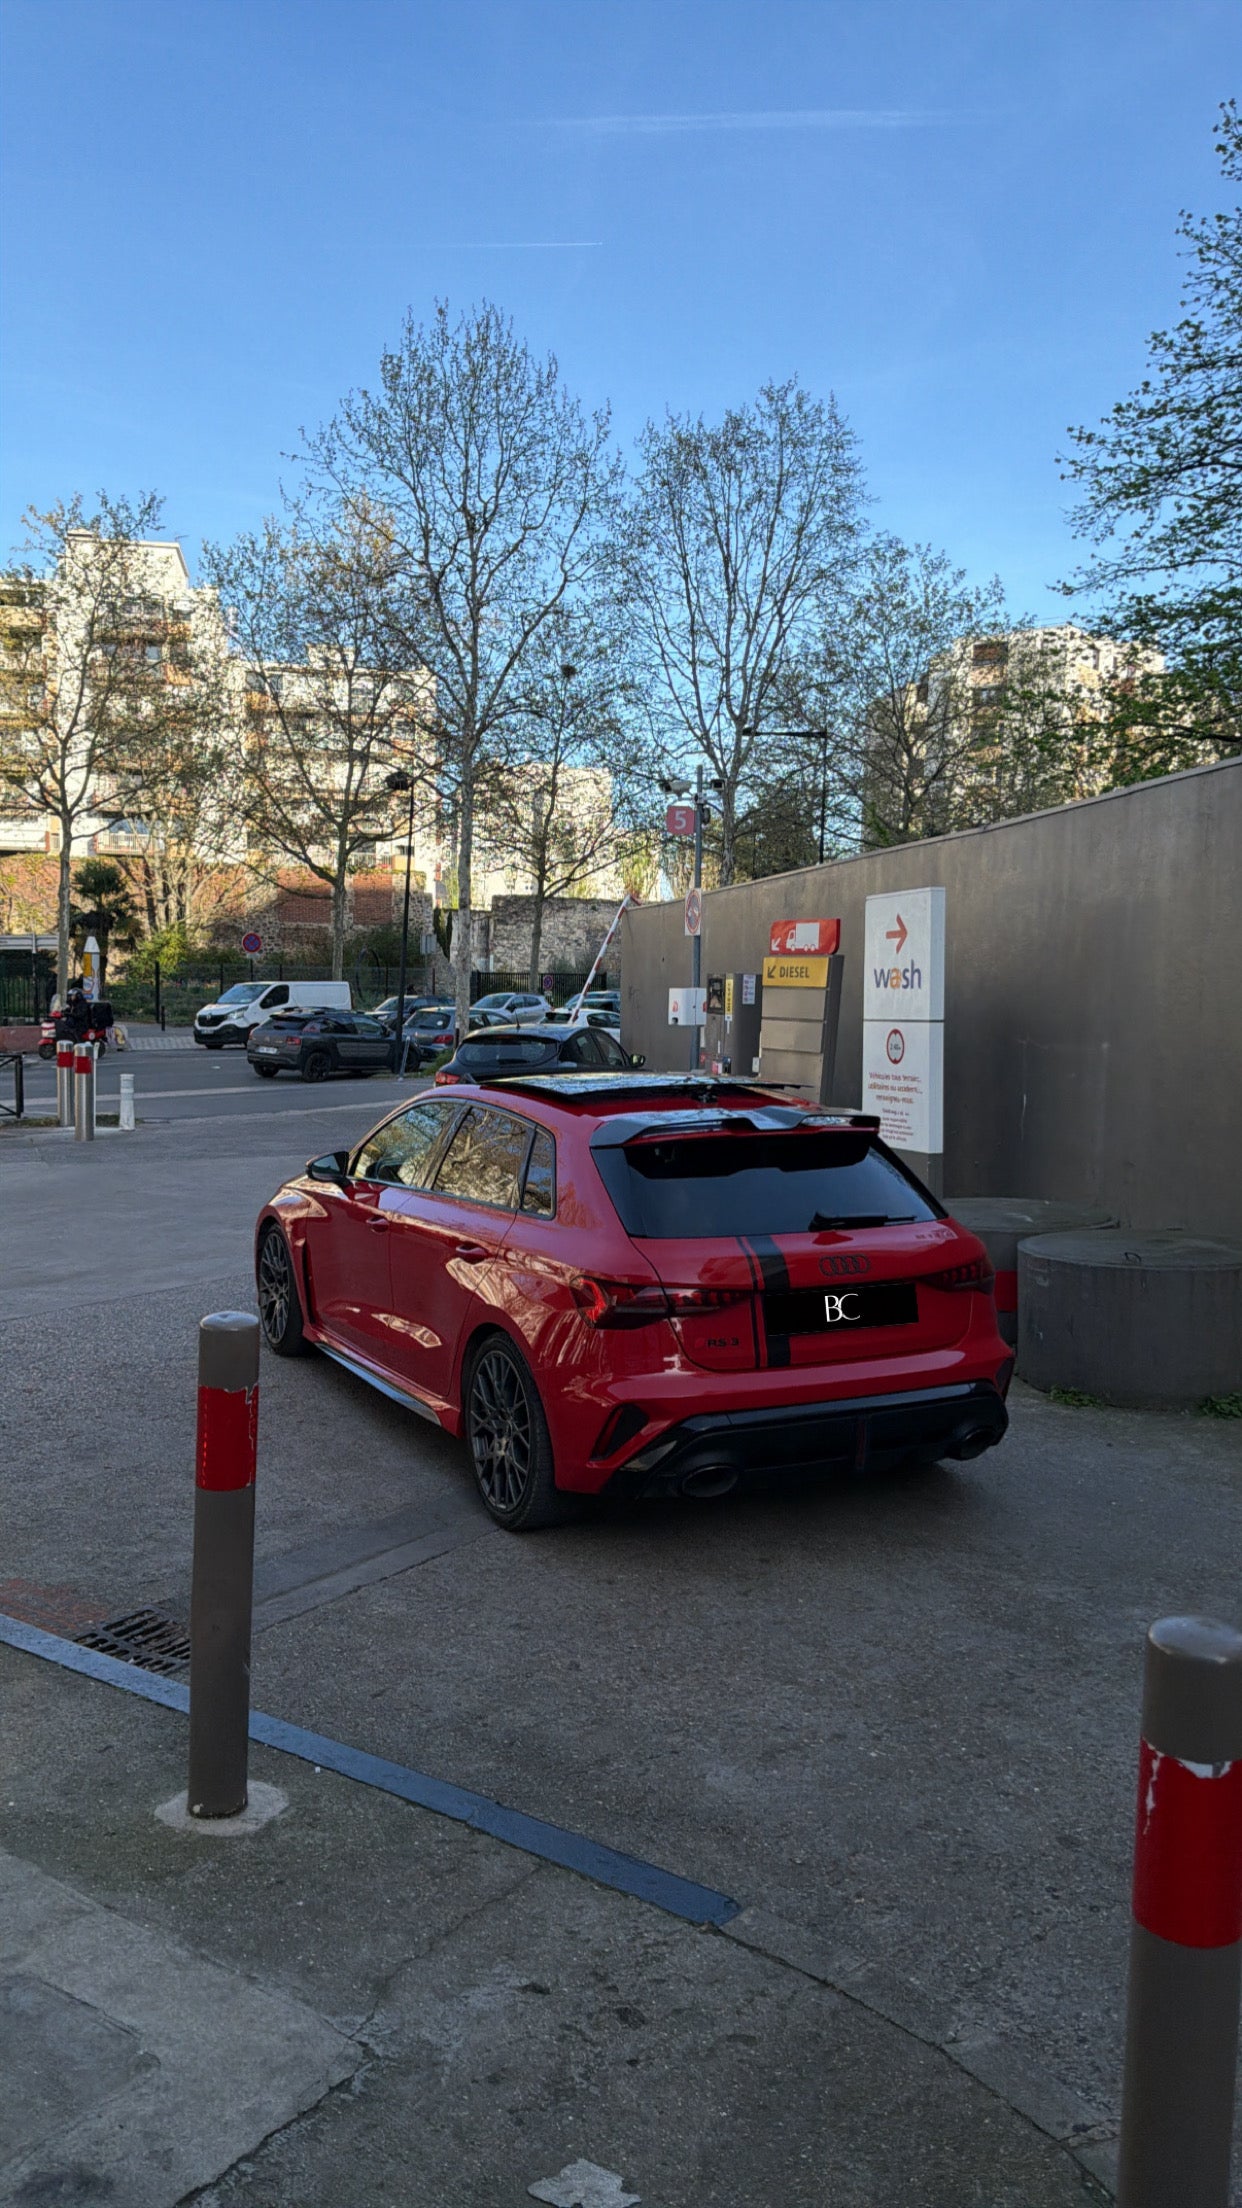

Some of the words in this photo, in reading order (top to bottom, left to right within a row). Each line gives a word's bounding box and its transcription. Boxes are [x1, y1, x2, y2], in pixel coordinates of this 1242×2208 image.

[674, 810, 687, 830] 5
[779, 966, 810, 979] DIESEL
[873, 959, 922, 990] wash
[707, 1338, 727, 1347] RS
[731, 1337, 739, 1346] 3
